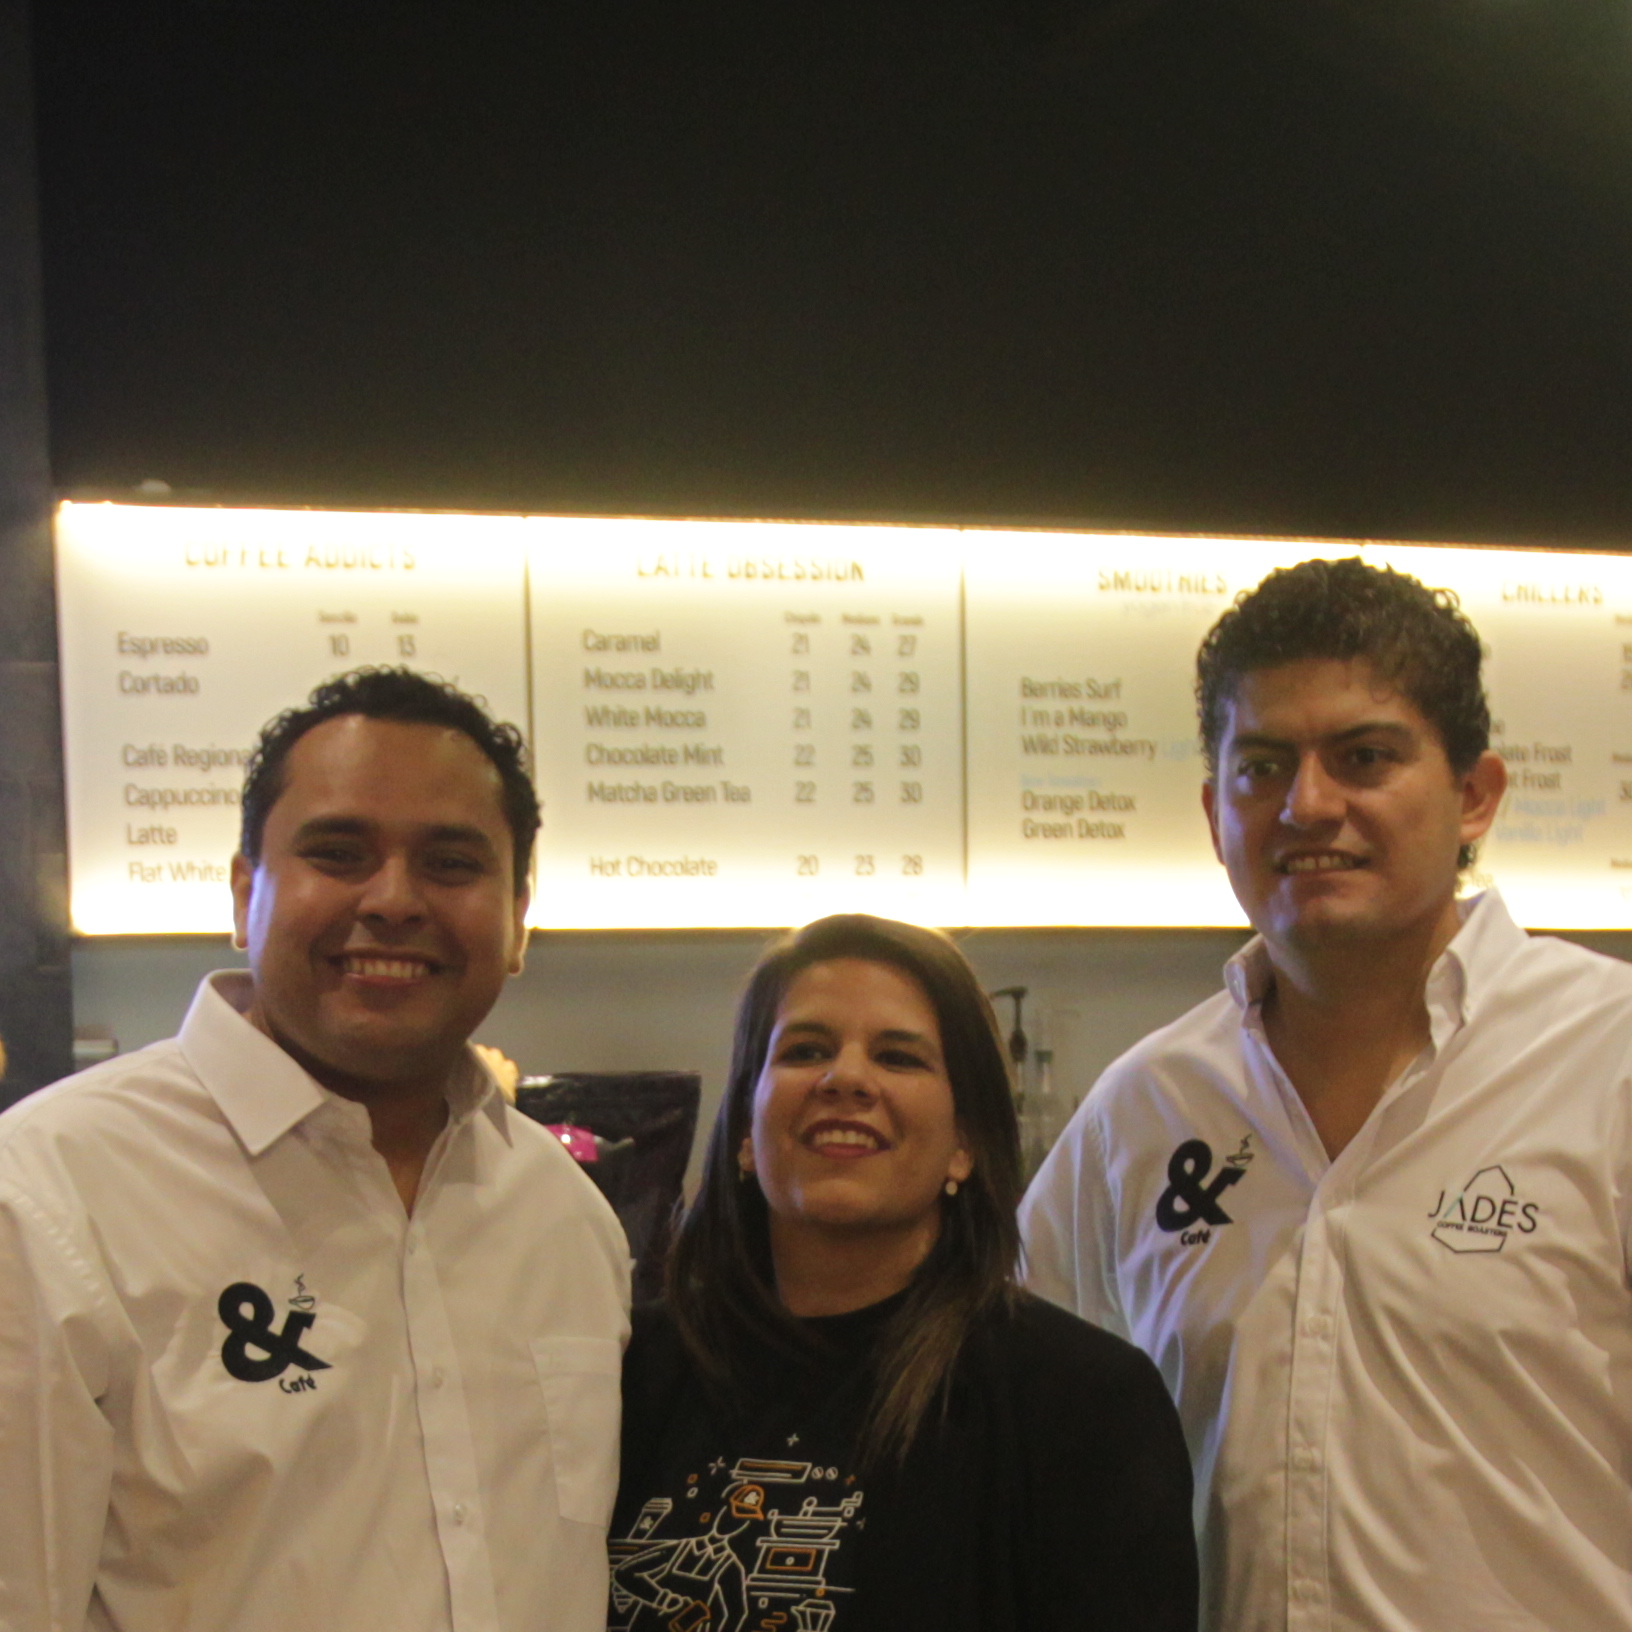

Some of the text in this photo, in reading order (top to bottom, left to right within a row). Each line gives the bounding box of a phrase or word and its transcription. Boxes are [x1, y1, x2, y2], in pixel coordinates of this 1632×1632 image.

[117, 630, 210, 659] Espresso
[328, 632, 350, 657] 10
[582, 627, 661, 654] Caramel
[790, 631, 811, 655] 21
[118, 669, 201, 695] Cortado
[584, 667, 715, 696] Mocca Delight
[790, 668, 812, 693] 21
[1020, 676, 1123, 700] Berries Surf
[584, 704, 707, 728] White Mocca
[791, 706, 813, 731] 21
[1068, 705, 1128, 732] Mango
[585, 742, 725, 768] Chocolate Mint
[792, 742, 817, 768] 22
[1021, 731, 1059, 756] Wild
[1062, 733, 1157, 762] Strawberry
[1533, 741, 1573, 766] Frost
[586, 780, 753, 805] Matcha Green Tea
[792, 780, 818, 805] 22
[1521, 768, 1562, 792] Frost
[124, 783, 242, 810] Cappuccino
[1021, 788, 1137, 817] Orange Detox
[126, 823, 178, 846] Latte
[1021, 816, 1127, 840] Green Detox
[128, 860, 228, 883] Flat White
[589, 855, 719, 878] Hot Chocolate
[796, 854, 820, 876] 20
[1427, 1188, 1539, 1234] JADES
